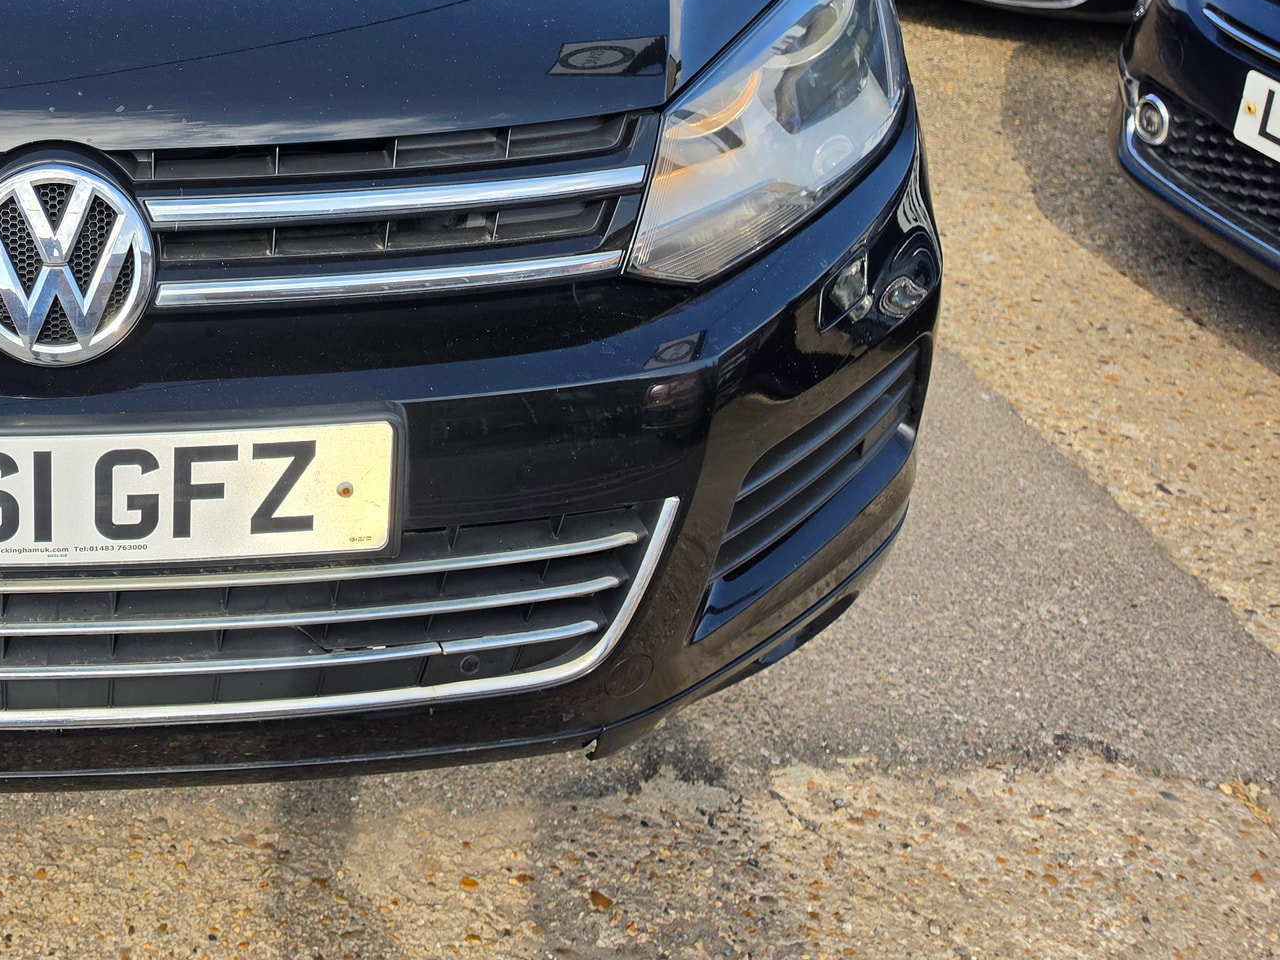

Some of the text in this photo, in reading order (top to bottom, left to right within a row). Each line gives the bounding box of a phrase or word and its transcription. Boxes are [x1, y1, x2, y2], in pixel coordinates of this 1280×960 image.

[94, 440, 317, 542] GFZ
[73, 545, 115, 553] Tel:01483
[117, 544, 148, 552] 763000
